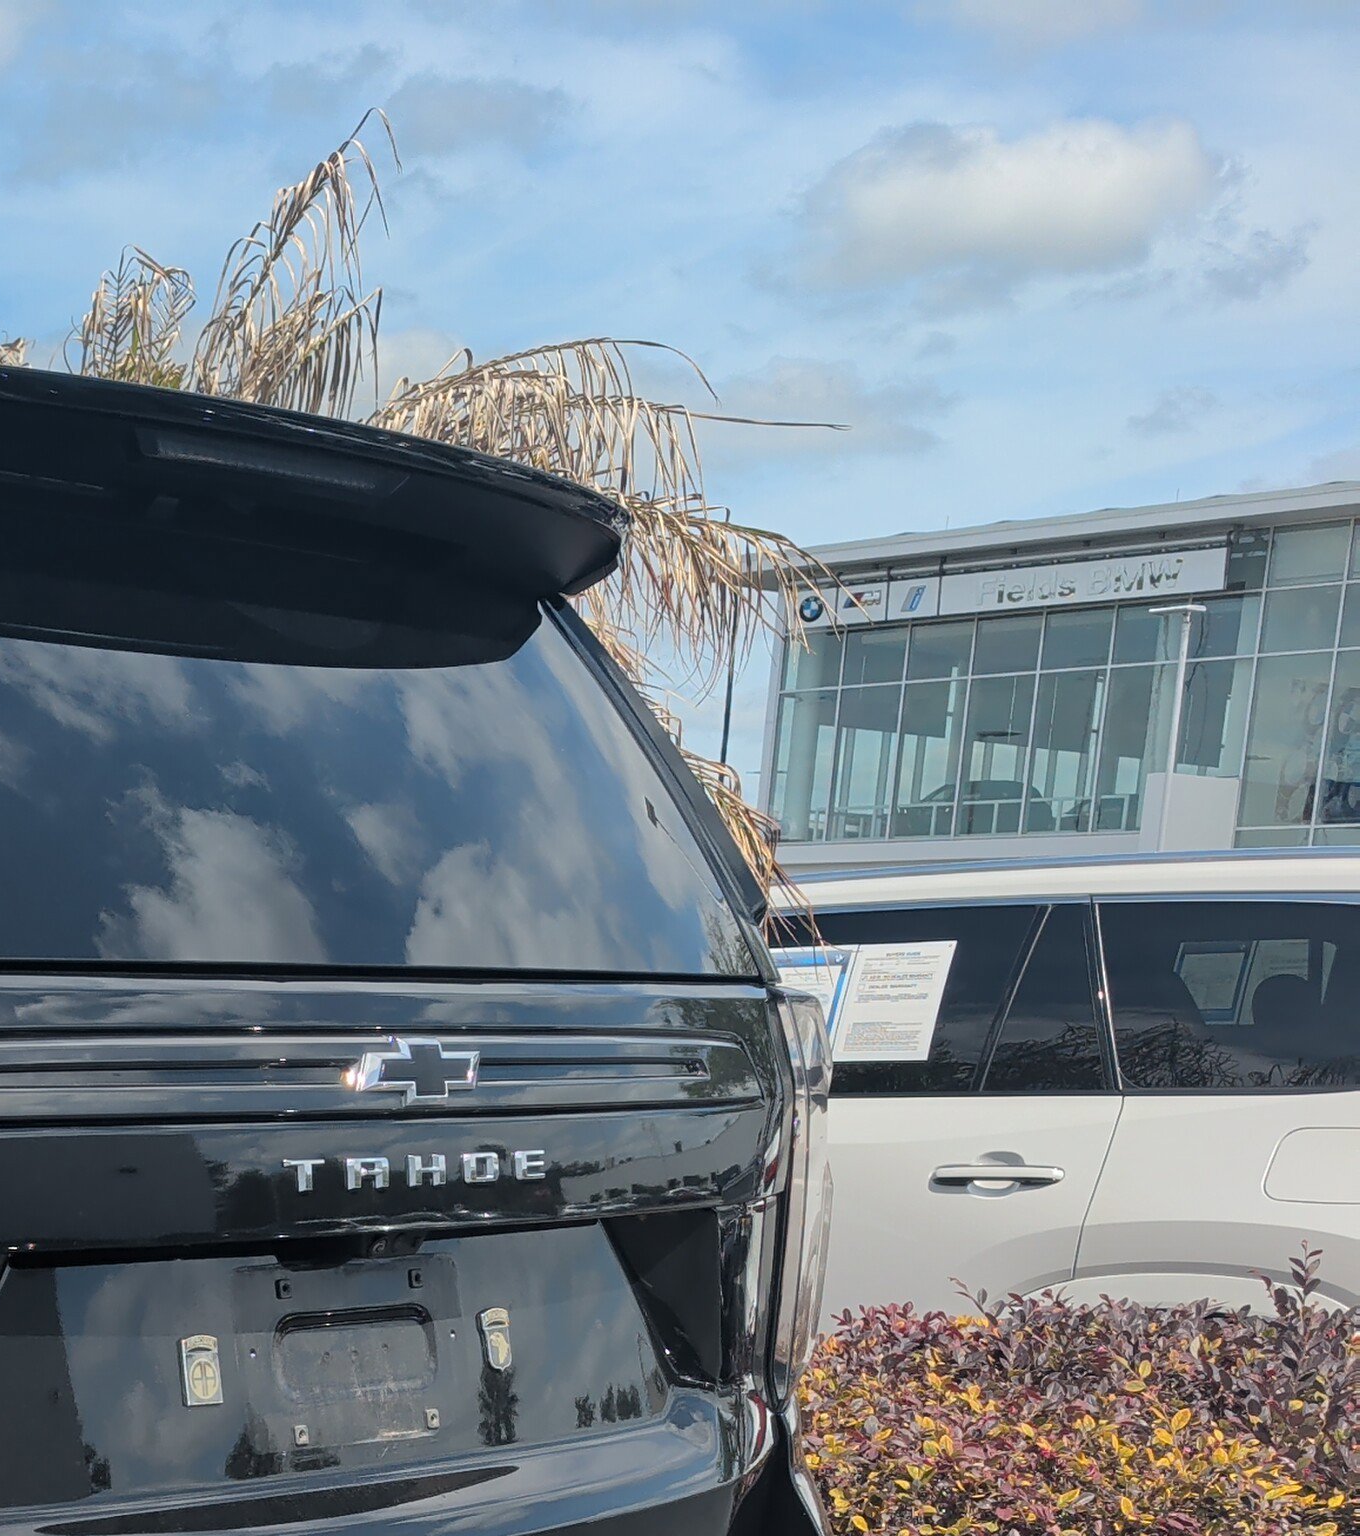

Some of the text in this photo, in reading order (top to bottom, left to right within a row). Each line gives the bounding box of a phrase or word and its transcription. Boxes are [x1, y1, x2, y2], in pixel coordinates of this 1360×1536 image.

[977, 558, 1183, 606] Fields BMW
[282, 1150, 546, 1193] TAHOE
